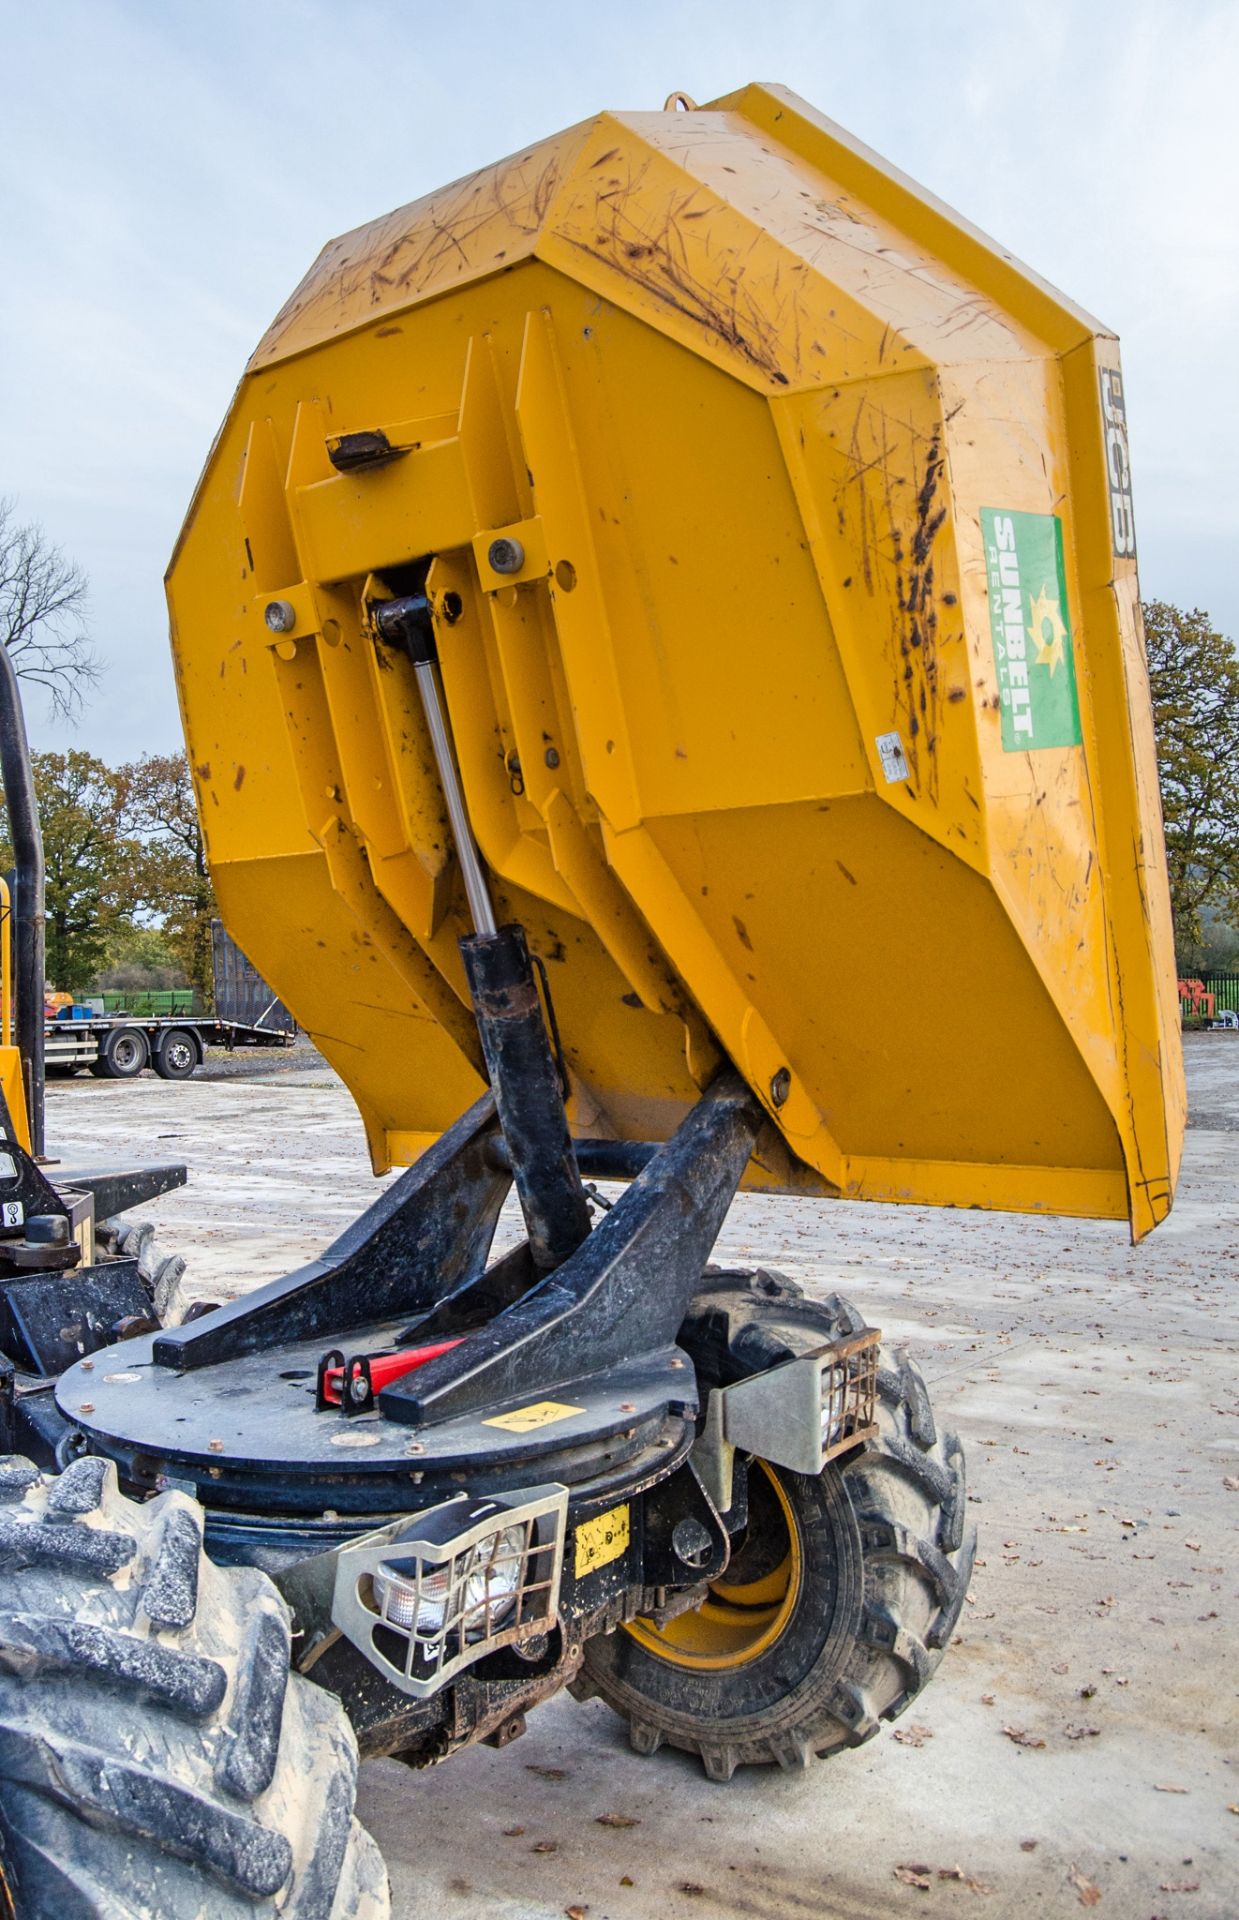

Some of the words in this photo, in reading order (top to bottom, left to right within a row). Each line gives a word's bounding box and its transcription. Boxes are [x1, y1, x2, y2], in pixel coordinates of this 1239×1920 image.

[1101, 372, 1136, 554] JCB
[988, 546, 1012, 706] RENTALS
[994, 516, 1033, 738] SUNBELT
